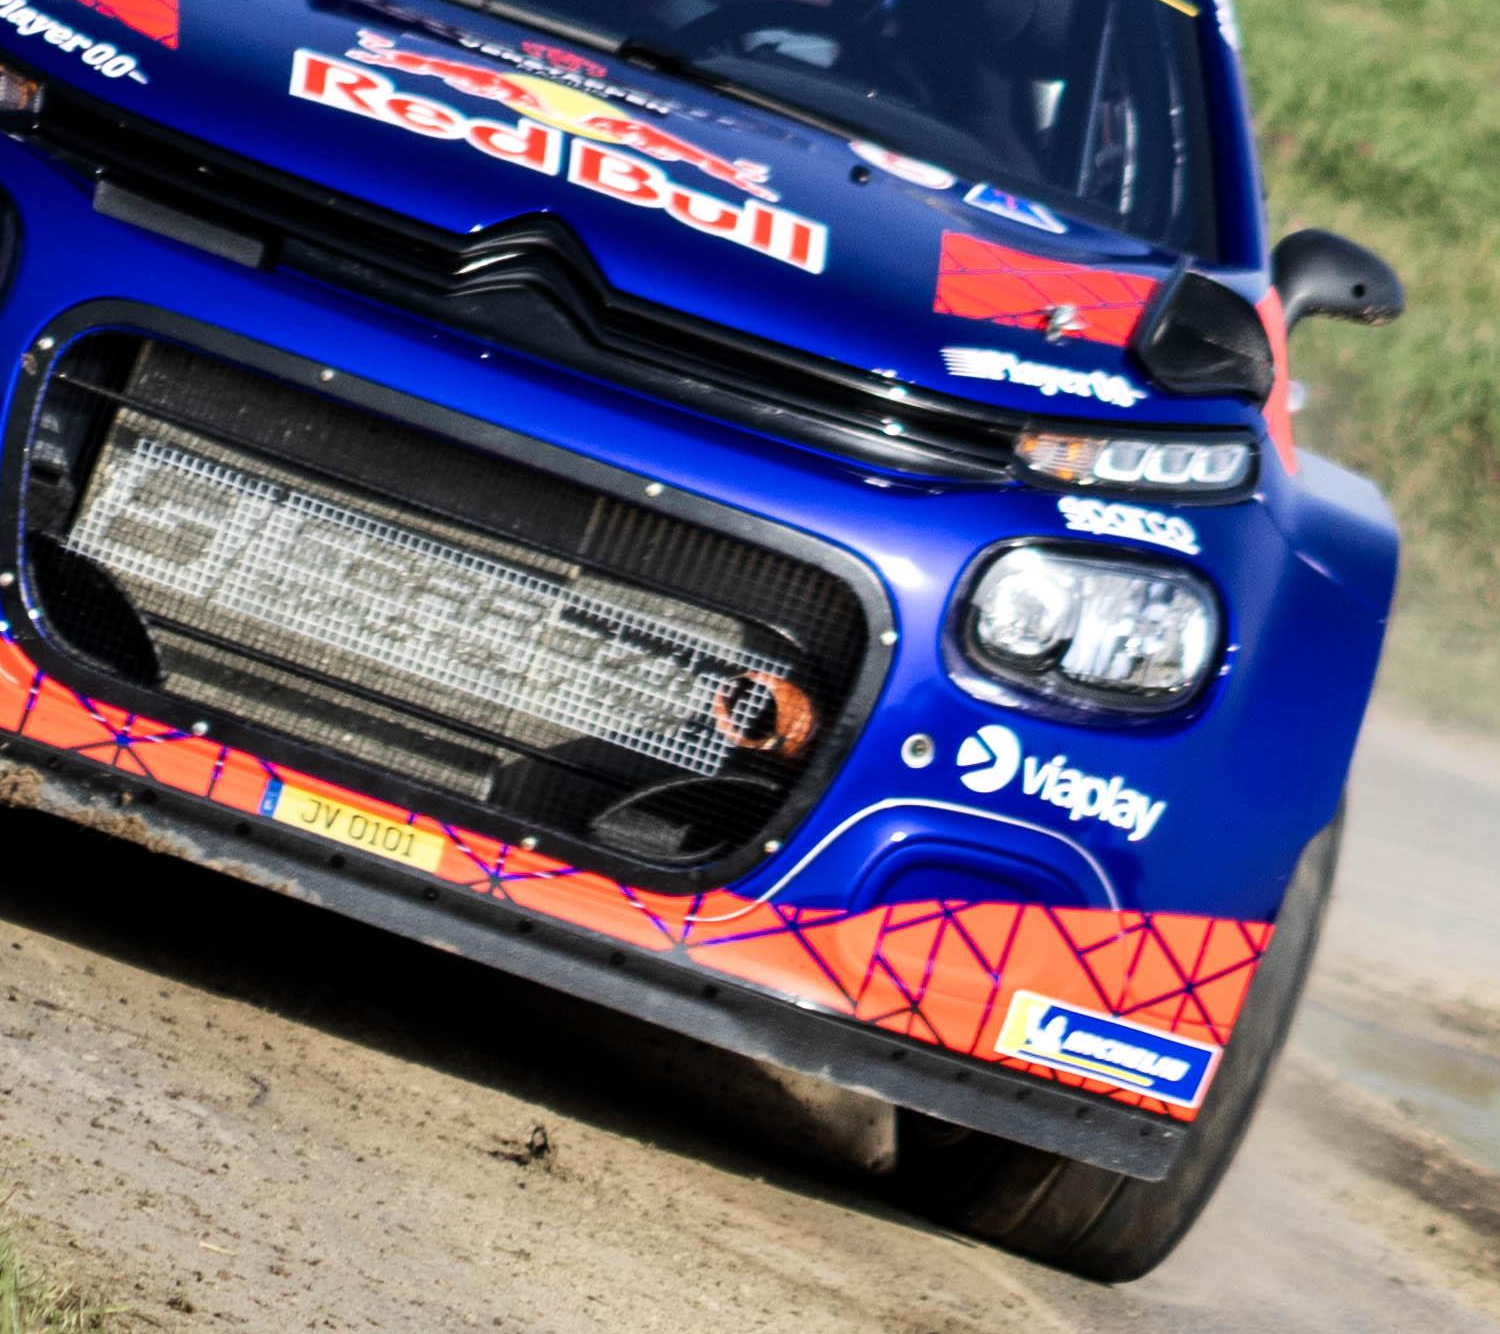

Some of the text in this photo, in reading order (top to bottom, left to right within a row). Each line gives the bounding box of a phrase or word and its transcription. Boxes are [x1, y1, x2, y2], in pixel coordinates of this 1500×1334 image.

[289, 49, 828, 274] Red Bull
[300, 798, 341, 829] JV
[348, 814, 416, 857] 0101
[1022, 754, 1167, 842] viaplay
